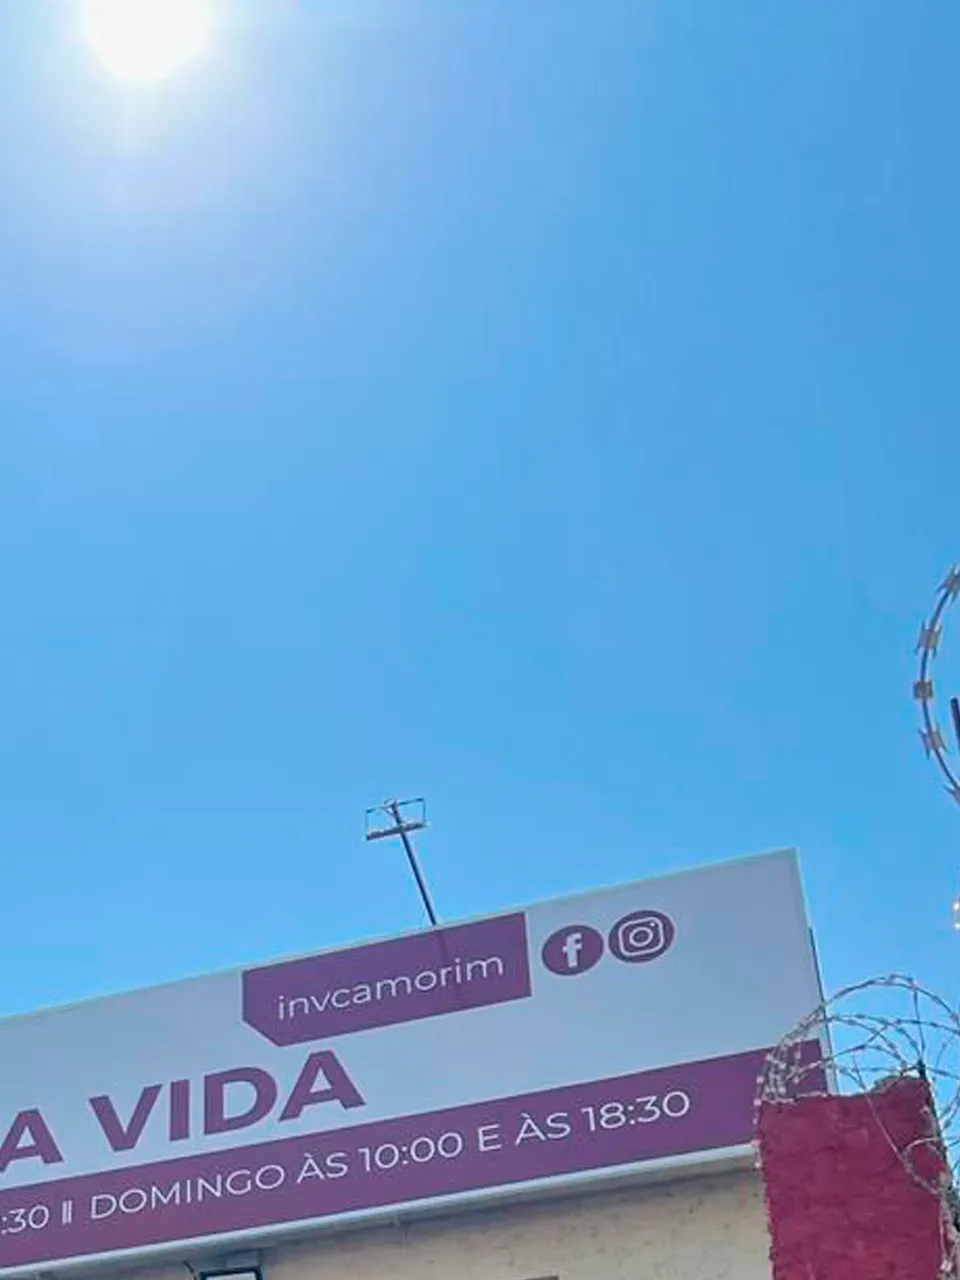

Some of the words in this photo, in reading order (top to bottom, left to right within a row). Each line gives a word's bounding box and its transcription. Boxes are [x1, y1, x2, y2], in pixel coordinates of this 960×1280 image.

[276, 952, 504, 1021] invcamorim
[88, 1049, 367, 1153] VIDA
[90, 1163, 287, 1220] DOMINGO
[296, 1146, 349, 1185] ÀS
[357, 1131, 464, 1173] 10:00
[477, 1122, 503, 1153] E
[513, 1111, 572, 1148] ÀS
[581, 1089, 691, 1133] 18:30
